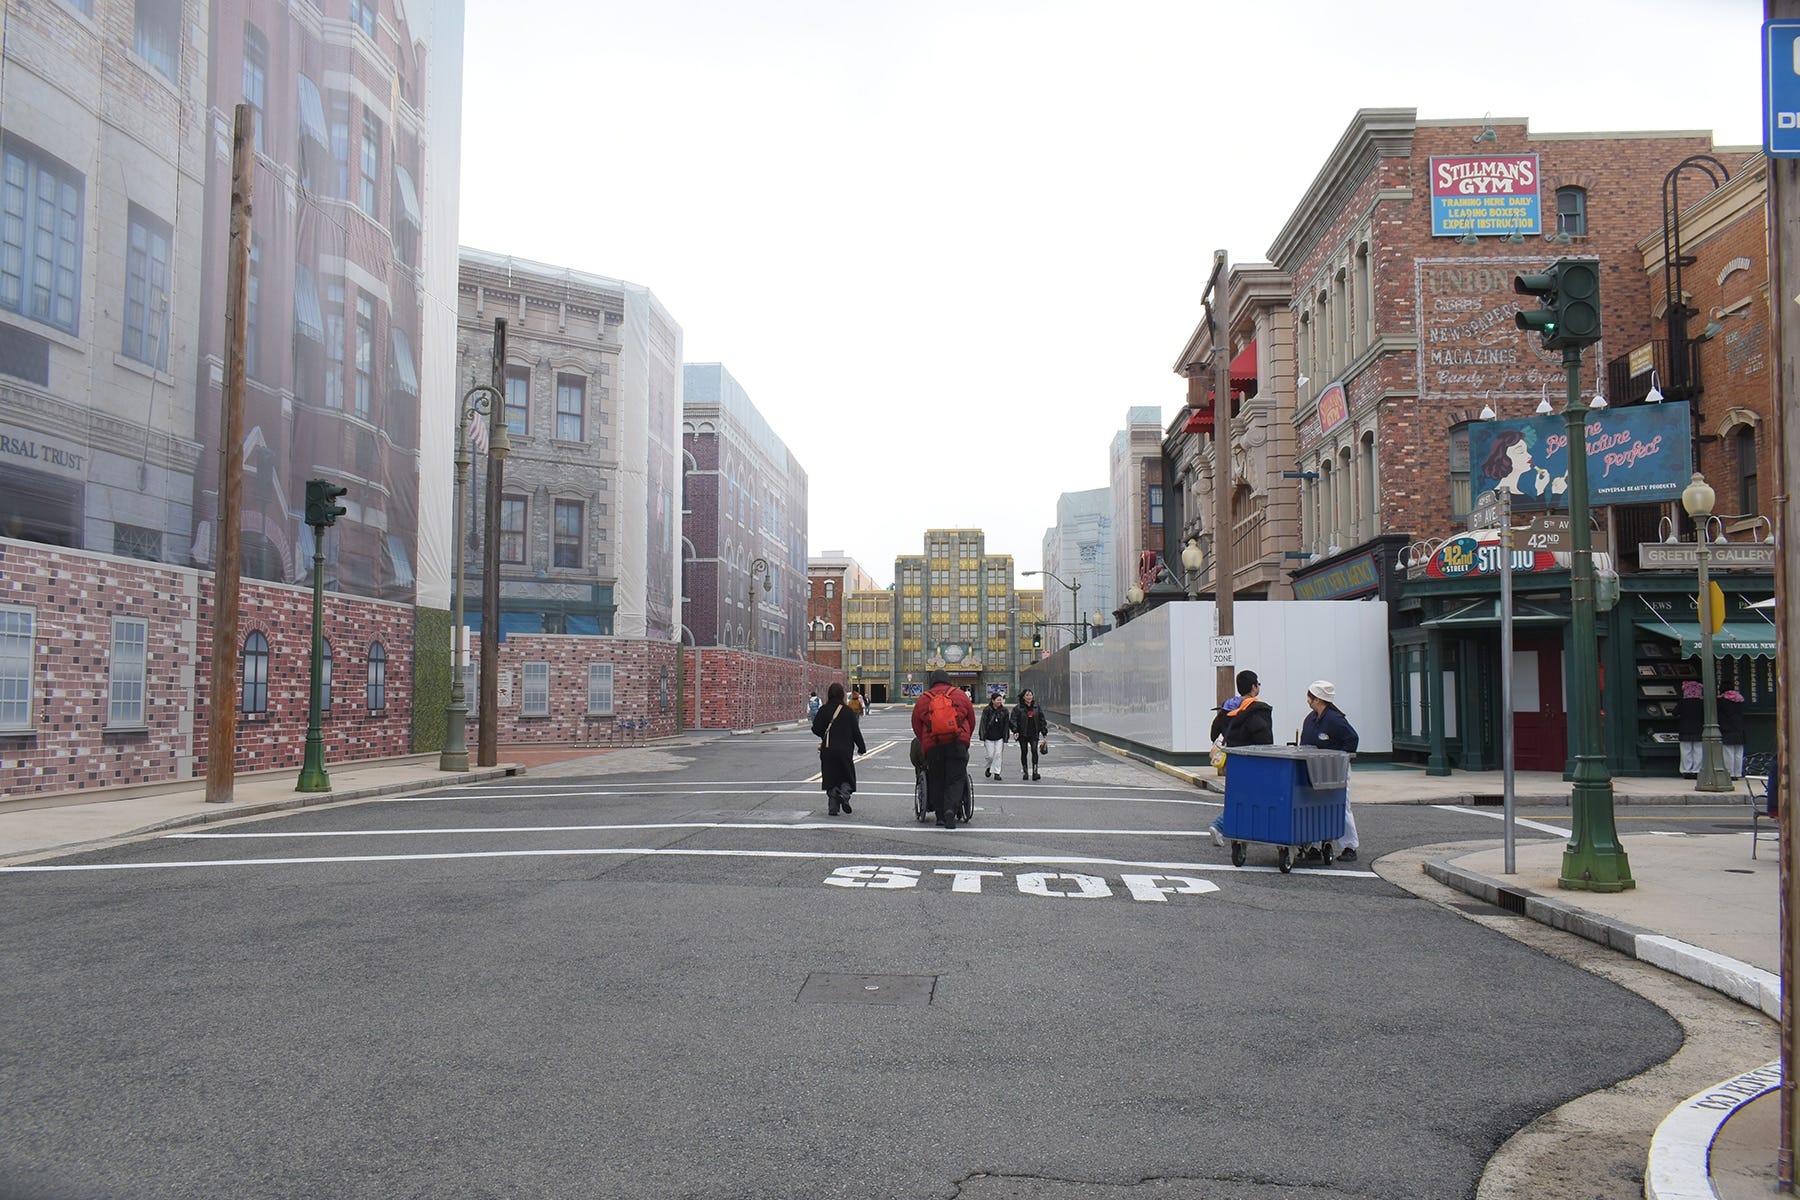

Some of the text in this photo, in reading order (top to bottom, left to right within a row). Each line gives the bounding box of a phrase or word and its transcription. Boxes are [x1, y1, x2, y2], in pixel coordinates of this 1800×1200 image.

[1438, 161, 1534, 188] STILLMAN'S
[1459, 177, 1514, 194] GYM
[1442, 197, 1532, 207] TRAINING HERE DAILY
[1448, 207, 1527, 218] LEADING BOXERS
[1443, 218, 1534, 229] EXPERT INSTRUCTION
[1428, 268, 1511, 295] UNION
[1430, 301, 1522, 342] NEWSPAPERS
[1431, 348, 1518, 366] MAGAZINES
[1436, 369, 1486, 389] Candy
[41, 444, 83, 471] TRUST
[1598, 486, 1626, 494] UNIVERSAL
[1473, 512, 1482, 527] 5TH
[1543, 520, 1555, 529] 5TH
[1527, 534, 1560, 548] 42ND
[1443, 545, 1473, 566] 42nd
[1715, 550, 1775, 561] GALLERY
[1446, 564, 1469, 573] STREET
[1215, 638, 1230, 646] TOW
[1213, 646, 1232, 654] AWAY
[1213, 655, 1232, 663] ZONE
[823, 865, 1221, 902] STOP
